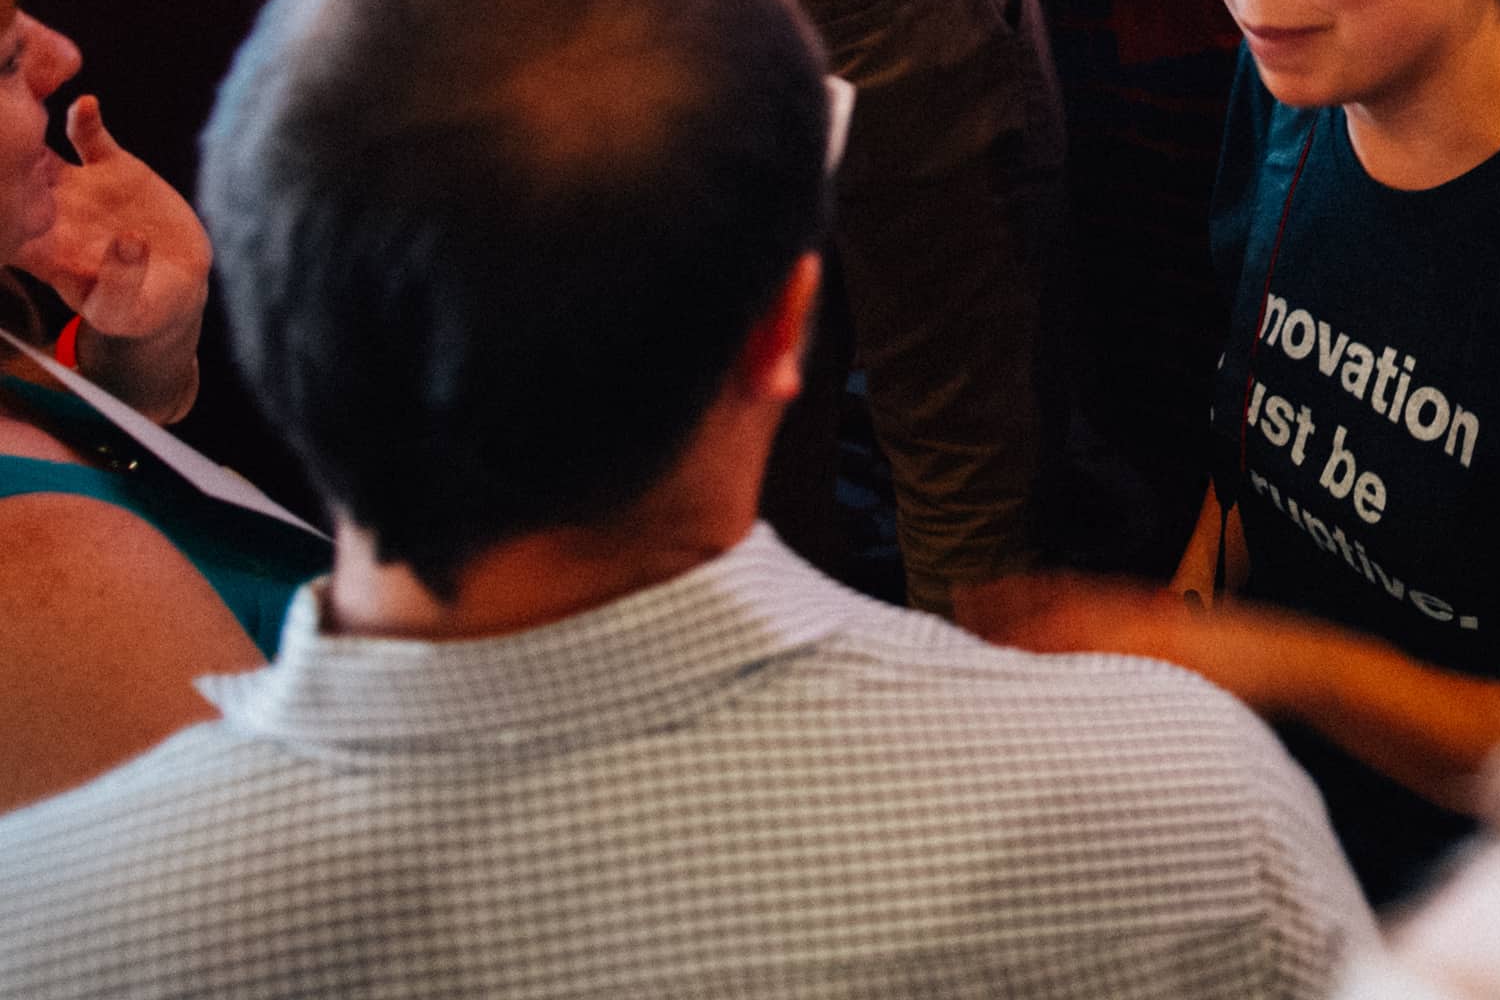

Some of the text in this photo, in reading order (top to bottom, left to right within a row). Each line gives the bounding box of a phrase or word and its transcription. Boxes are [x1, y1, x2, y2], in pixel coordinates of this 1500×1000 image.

[1259, 293, 1480, 469] novation
[1250, 469, 1480, 631] ruptive.
[1319, 424, 1388, 525] be
